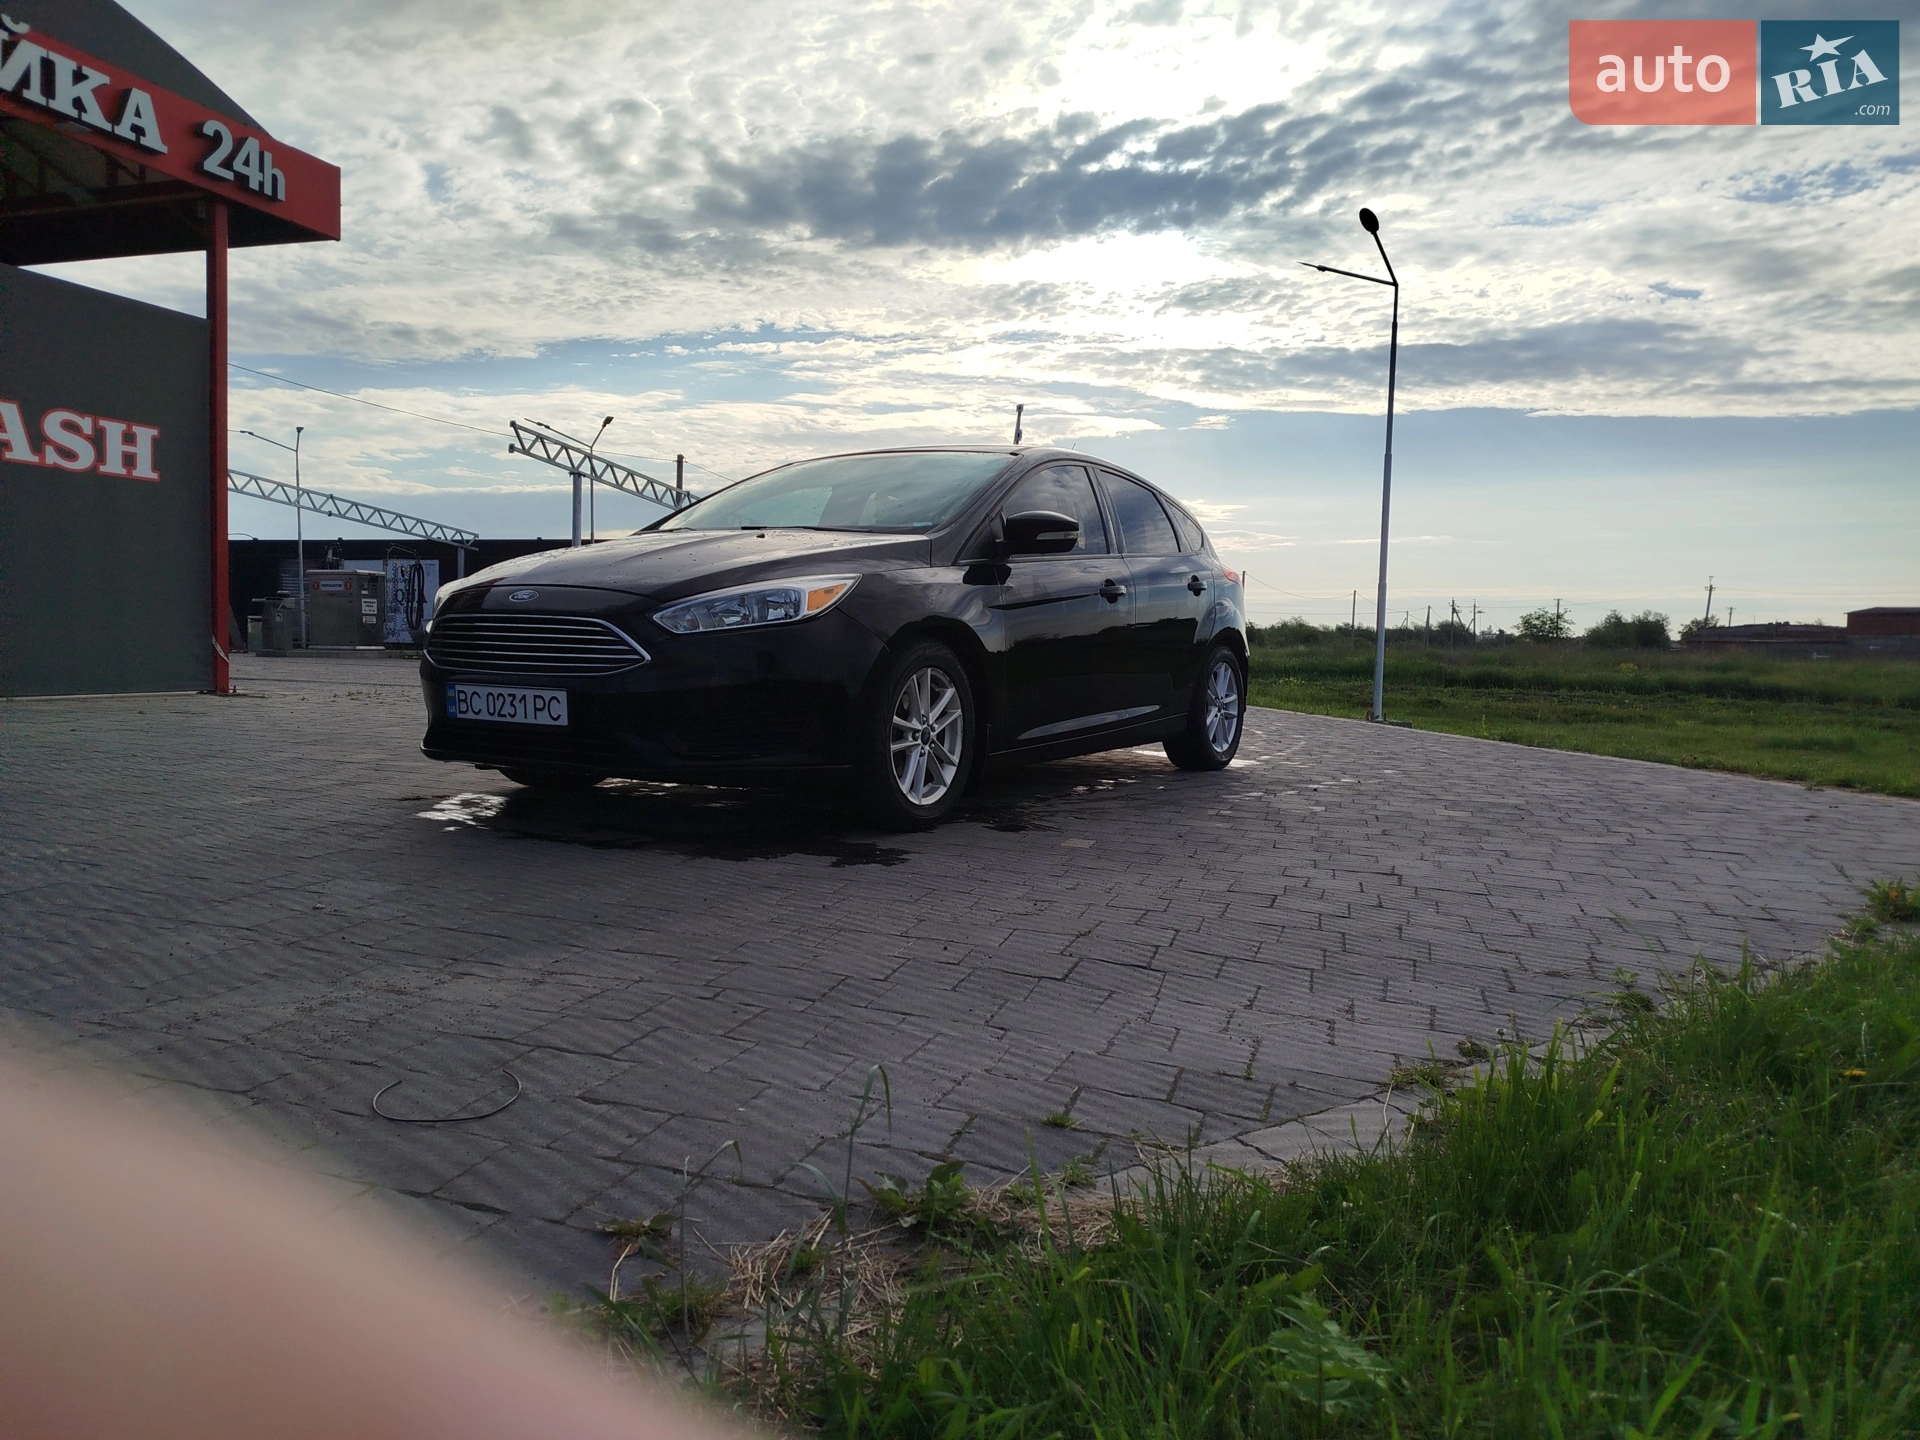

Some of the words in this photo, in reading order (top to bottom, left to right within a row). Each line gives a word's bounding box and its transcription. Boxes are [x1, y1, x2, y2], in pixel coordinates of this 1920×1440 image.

[202, 119, 286, 202] 24h
[457, 689, 482, 715] BC
[486, 691, 528, 719] 0231
[533, 694, 562, 721] PC
